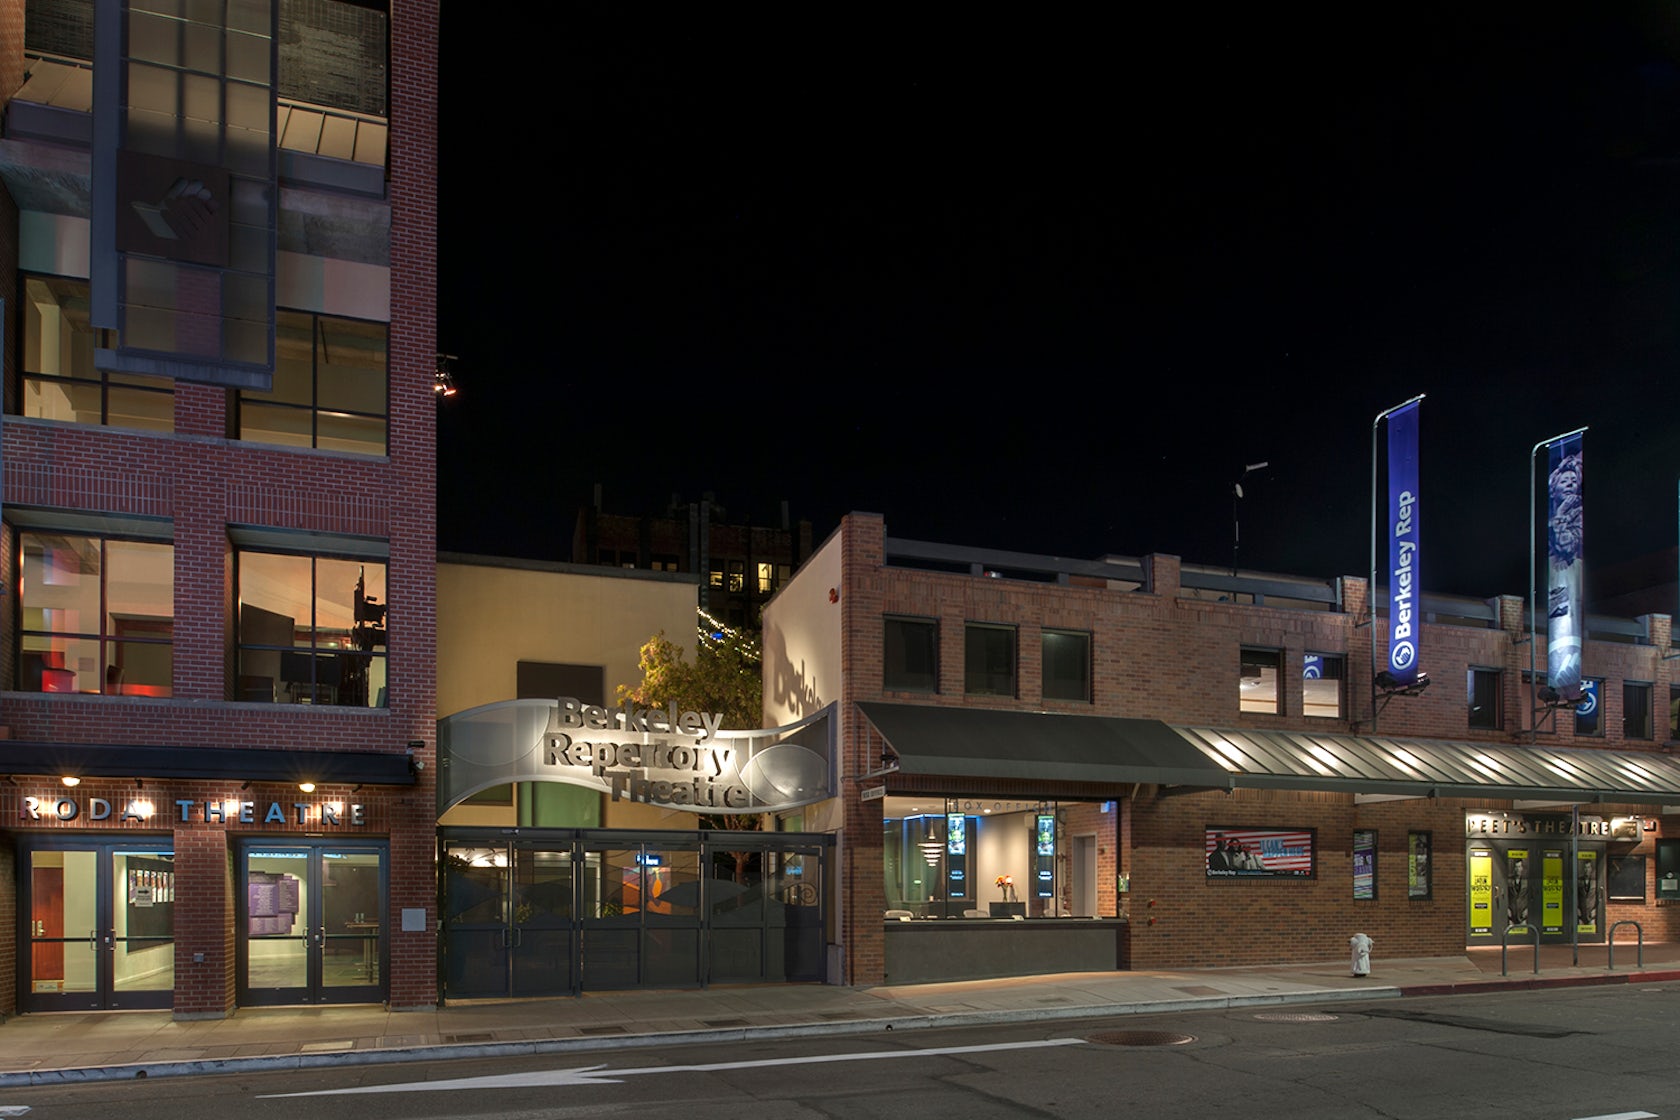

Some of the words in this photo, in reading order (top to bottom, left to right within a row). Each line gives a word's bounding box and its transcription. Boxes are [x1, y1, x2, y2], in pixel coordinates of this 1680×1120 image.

[1396, 490, 1416, 537] Rep
[1394, 541, 1417, 640] Berkeley
[557, 696, 724, 742] Berkeley
[543, 732, 737, 777] Repertory
[605, 768, 751, 807] Theatre
[953, 801, 983, 811] BOX
[19, 796, 146, 822] RODA
[175, 799, 366, 827] THEATRE
[1467, 818, 1527, 834] PEET'S
[1534, 819, 1610, 836] THEATRE
